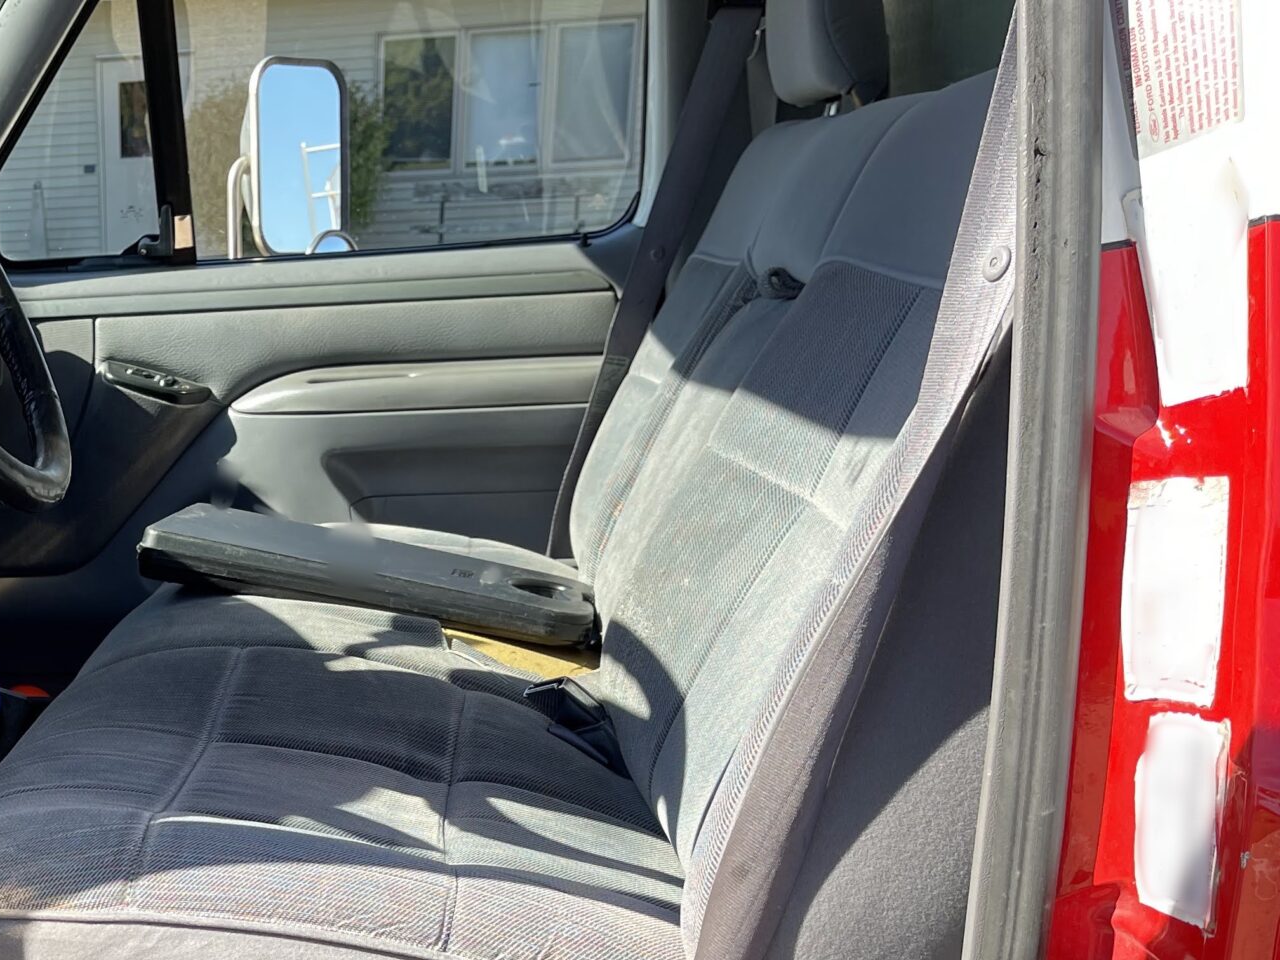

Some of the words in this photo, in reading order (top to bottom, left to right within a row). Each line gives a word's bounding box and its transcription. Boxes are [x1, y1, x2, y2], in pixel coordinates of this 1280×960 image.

[1129, 27, 1142, 87] INFORMATION
[1141, 44, 1151, 81] MOTOR
[1146, 84, 1155, 112] FORD
